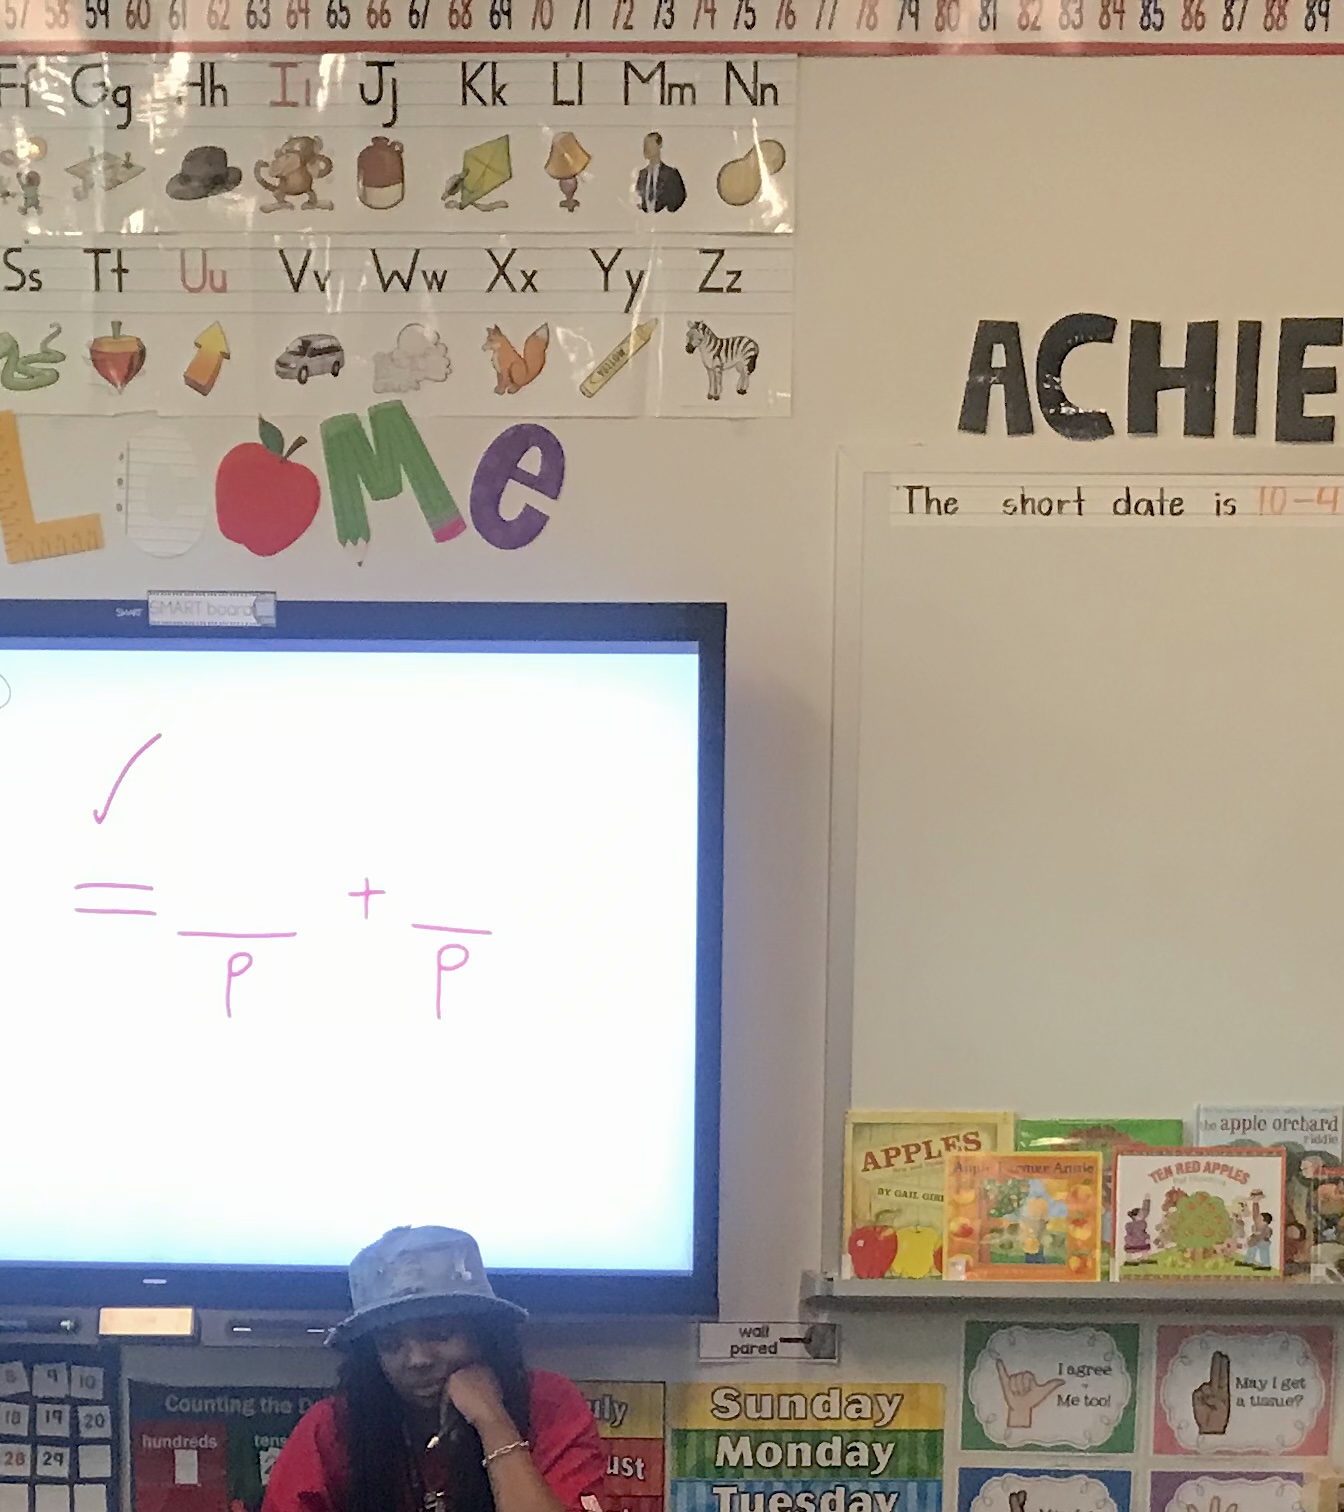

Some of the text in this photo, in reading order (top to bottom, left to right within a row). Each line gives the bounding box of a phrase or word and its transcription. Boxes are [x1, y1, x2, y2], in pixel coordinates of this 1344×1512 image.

[246, 0, 270, 29] 63
[1140, 0, 1164, 31] 85
[1304, 0, 1328, 31] 89
[72, 63, 131, 129] Gg
[359, 61, 400, 127] Jj
[460, 61, 507, 106] Kk
[623, 61, 696, 106] Mm
[725, 61, 778, 106] Nn
[3, 248, 43, 292] Ss
[84, 248, 129, 291] Tt
[181, 249, 227, 293] Uu
[370, 248, 447, 293] Ww
[485, 248, 539, 292] Xx
[590, 248, 645, 310] Yy
[697, 249, 743, 293] Zz
[902, 486, 960, 518] The
[1002, 485, 1087, 518] short
[1112, 485, 1186, 518] date
[1213, 490, 1238, 518] is
[149, 601, 254, 617] SMART board
[1220, 1114, 1338, 1135] apple orchard
[861, 1131, 983, 1172] APPLES
[1148, 1161, 1251, 1186] TEN RED APPLES
[878, 1187, 919, 1200] BY GAIL
[730, 1341, 778, 1358] pared
[1067, 1364, 1113, 1378] agree
[1235, 1376, 1306, 1393] May get
[165, 1394, 292, 1417] Counting the
[711, 1386, 903, 1428] Sunday
[1056, 1394, 1081, 1407] Me
[45, 1408, 62, 1424] 19
[84, 1413, 105, 1429] 20
[142, 1434, 218, 1449] hundreds
[43, 1452, 64, 1467] 29
[714, 1436, 895, 1474] Monday
